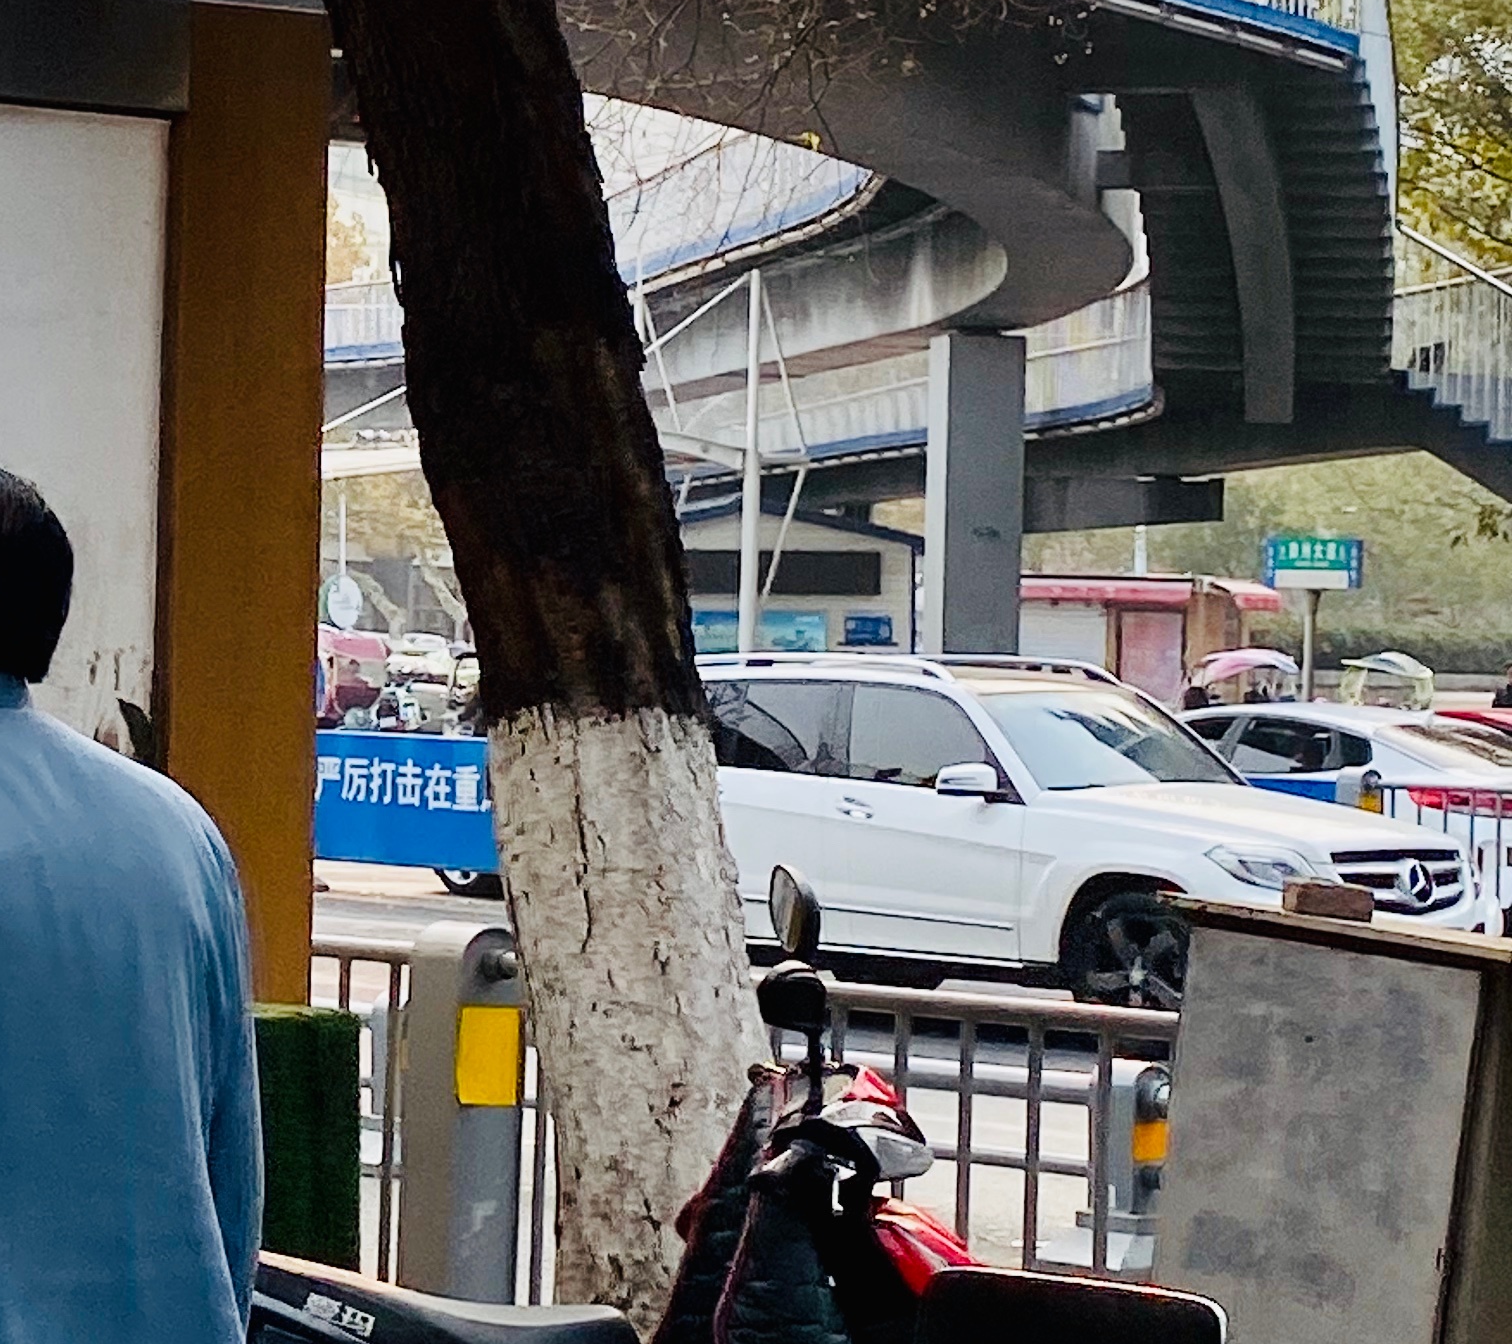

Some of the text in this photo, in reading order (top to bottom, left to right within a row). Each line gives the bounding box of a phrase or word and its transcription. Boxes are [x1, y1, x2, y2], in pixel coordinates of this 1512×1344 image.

[315, 756, 491, 813] 严厉打击在重
